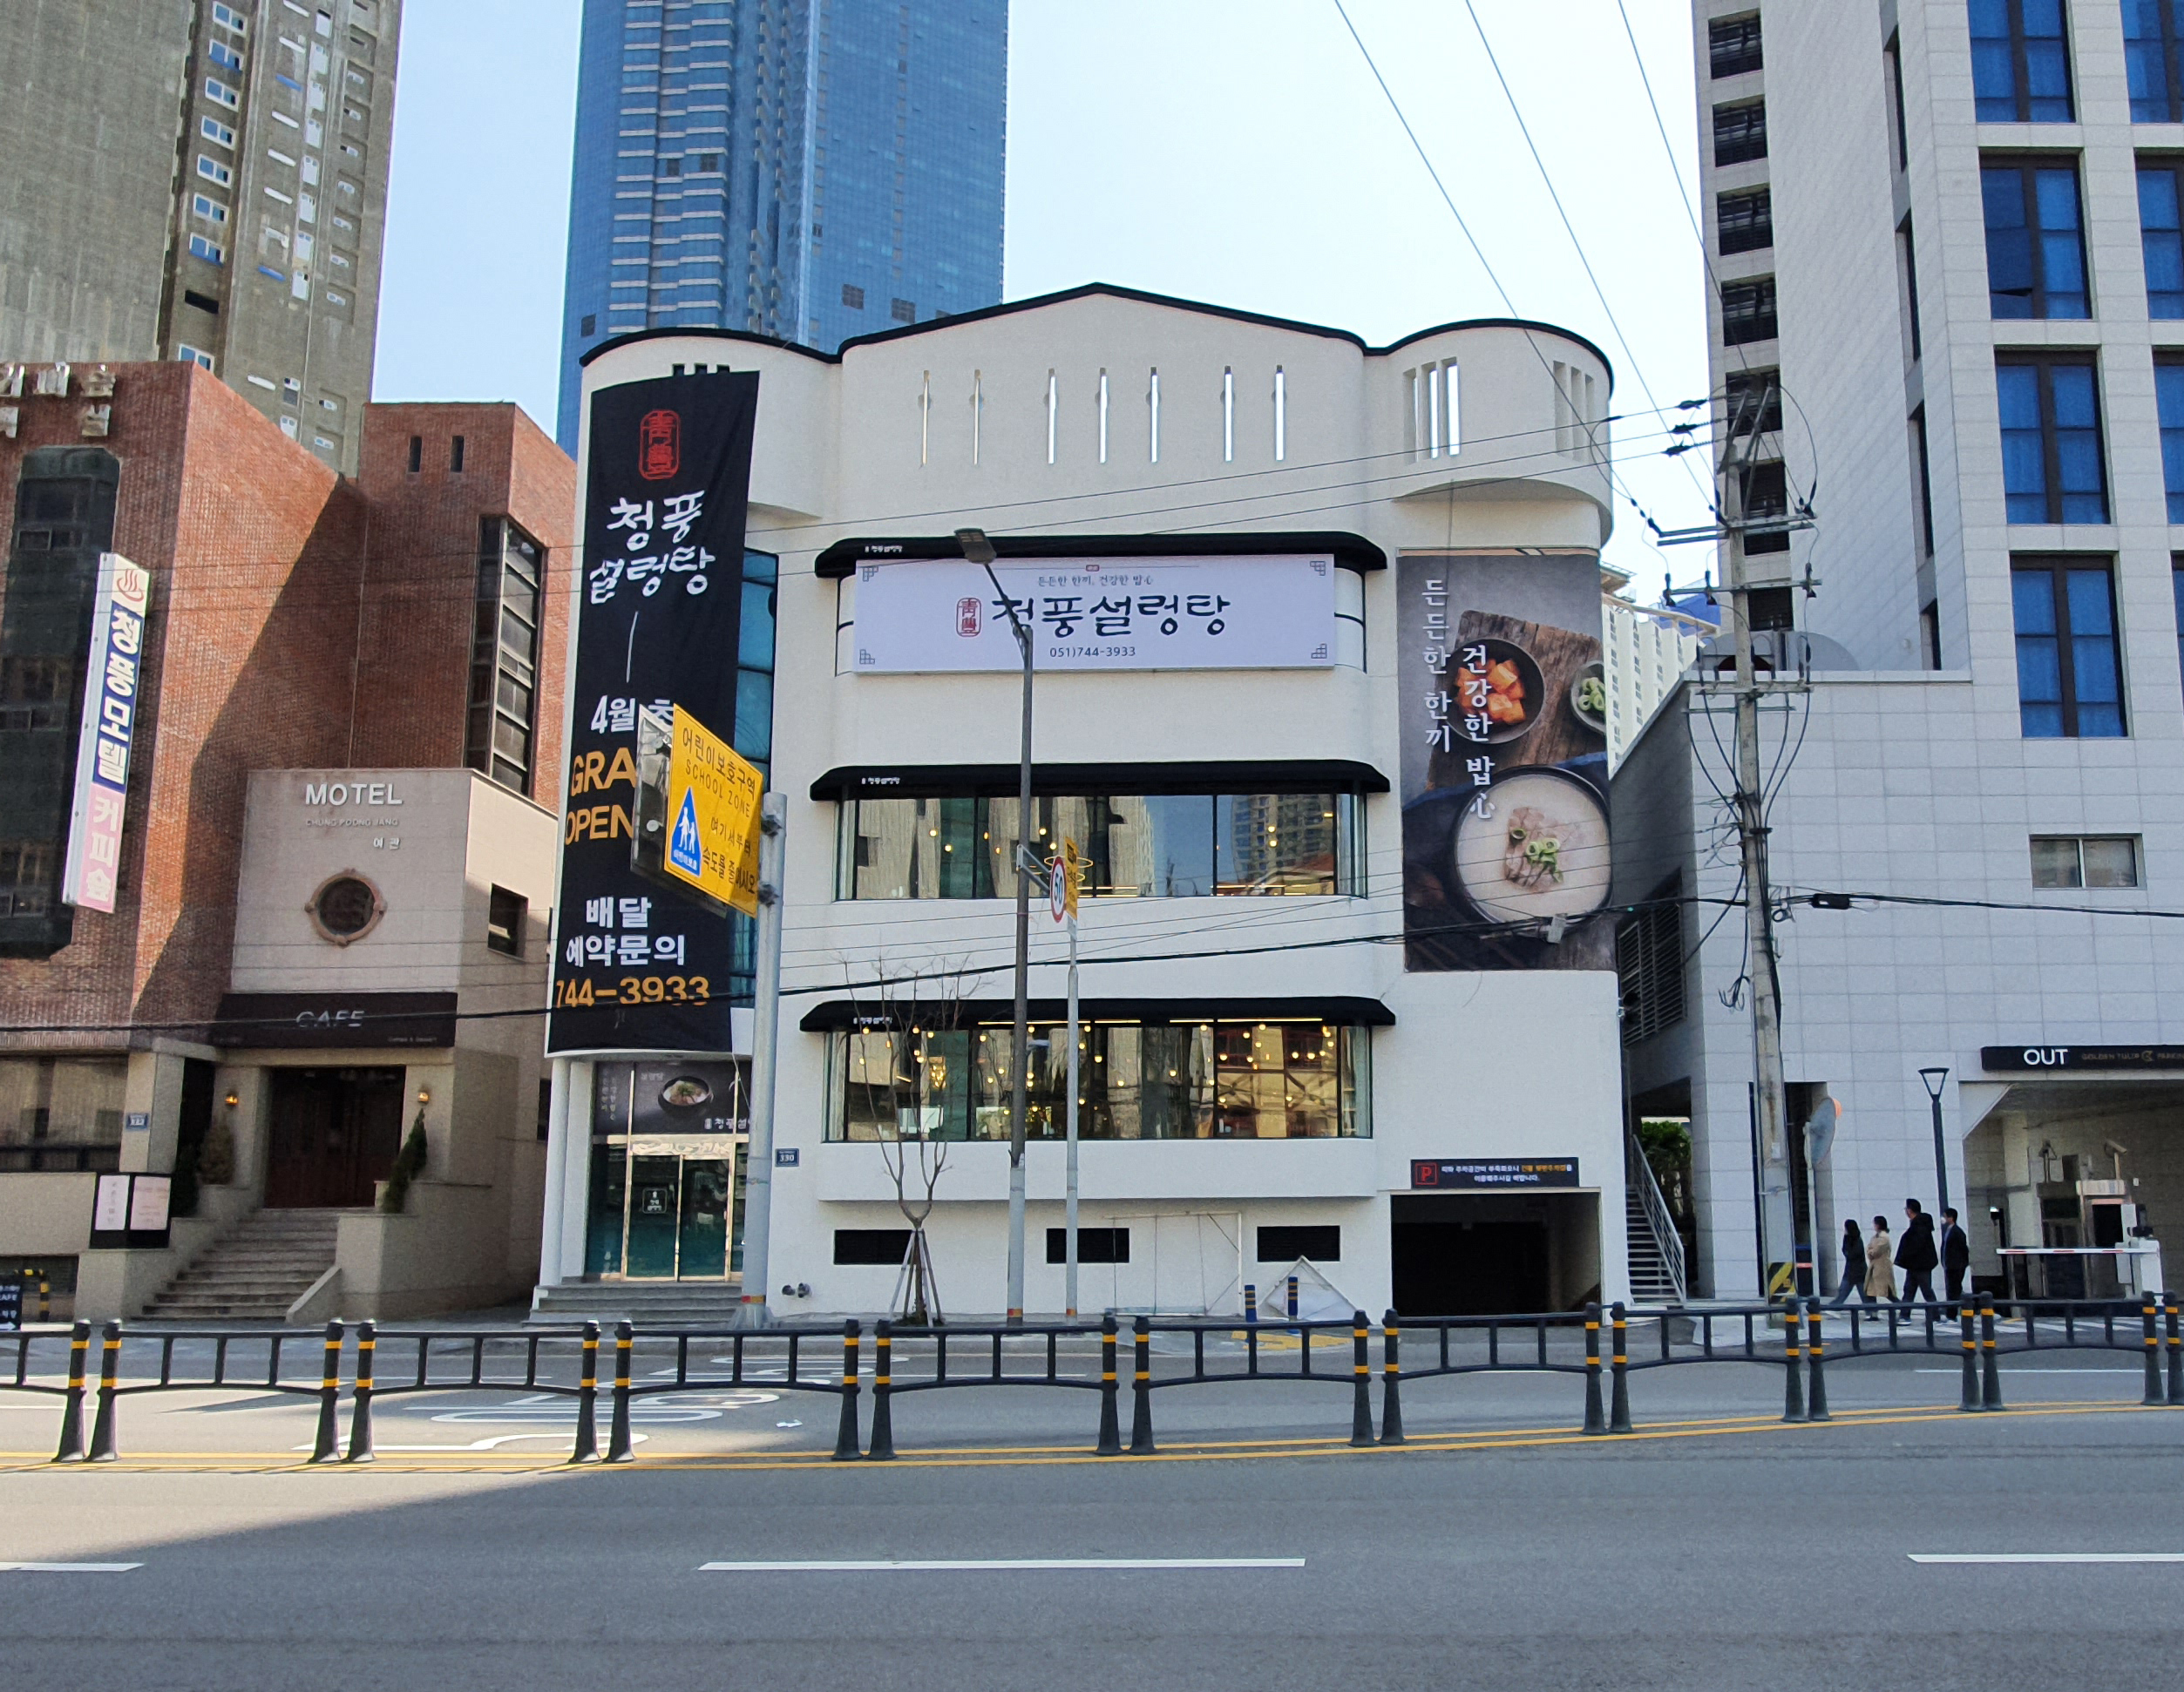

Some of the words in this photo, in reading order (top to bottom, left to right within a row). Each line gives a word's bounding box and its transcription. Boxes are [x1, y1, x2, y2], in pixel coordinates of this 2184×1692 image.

[607, 491, 705, 551] 청풍
[590, 546, 716, 605] 설렁탕
[1100, 575, 1129, 586] 건강한
[992, 595, 1231, 638] 청풍설렁탕
[1422, 579, 1450, 674] 든든한
[1049, 646, 1136, 658] 051)744-3933
[98, 610, 140, 784] 청풍모텔
[591, 695, 635, 734] 4월
[1462, 644, 1493, 744] 건강한
[1424, 691, 1452, 753] 한끼
[571, 747, 636, 796] GRA
[682, 727, 756, 802] 어린이보호구역
[305, 783, 403, 806] MOTEL
[686, 759, 724, 799] SCHOOL
[728, 789, 750, 818] ZONE
[85, 796, 120, 902] 커피숍
[702, 846, 726, 879] 속도를
[586, 897, 652, 929] 배달
[566, 934, 685, 968] 예약문의
[556, 976, 710, 1008] 744-3933
[295, 1010, 365, 1028] CAFE
[2023, 1048, 2068, 1065] OUT
[1421, 1167, 1432, 1182] P
